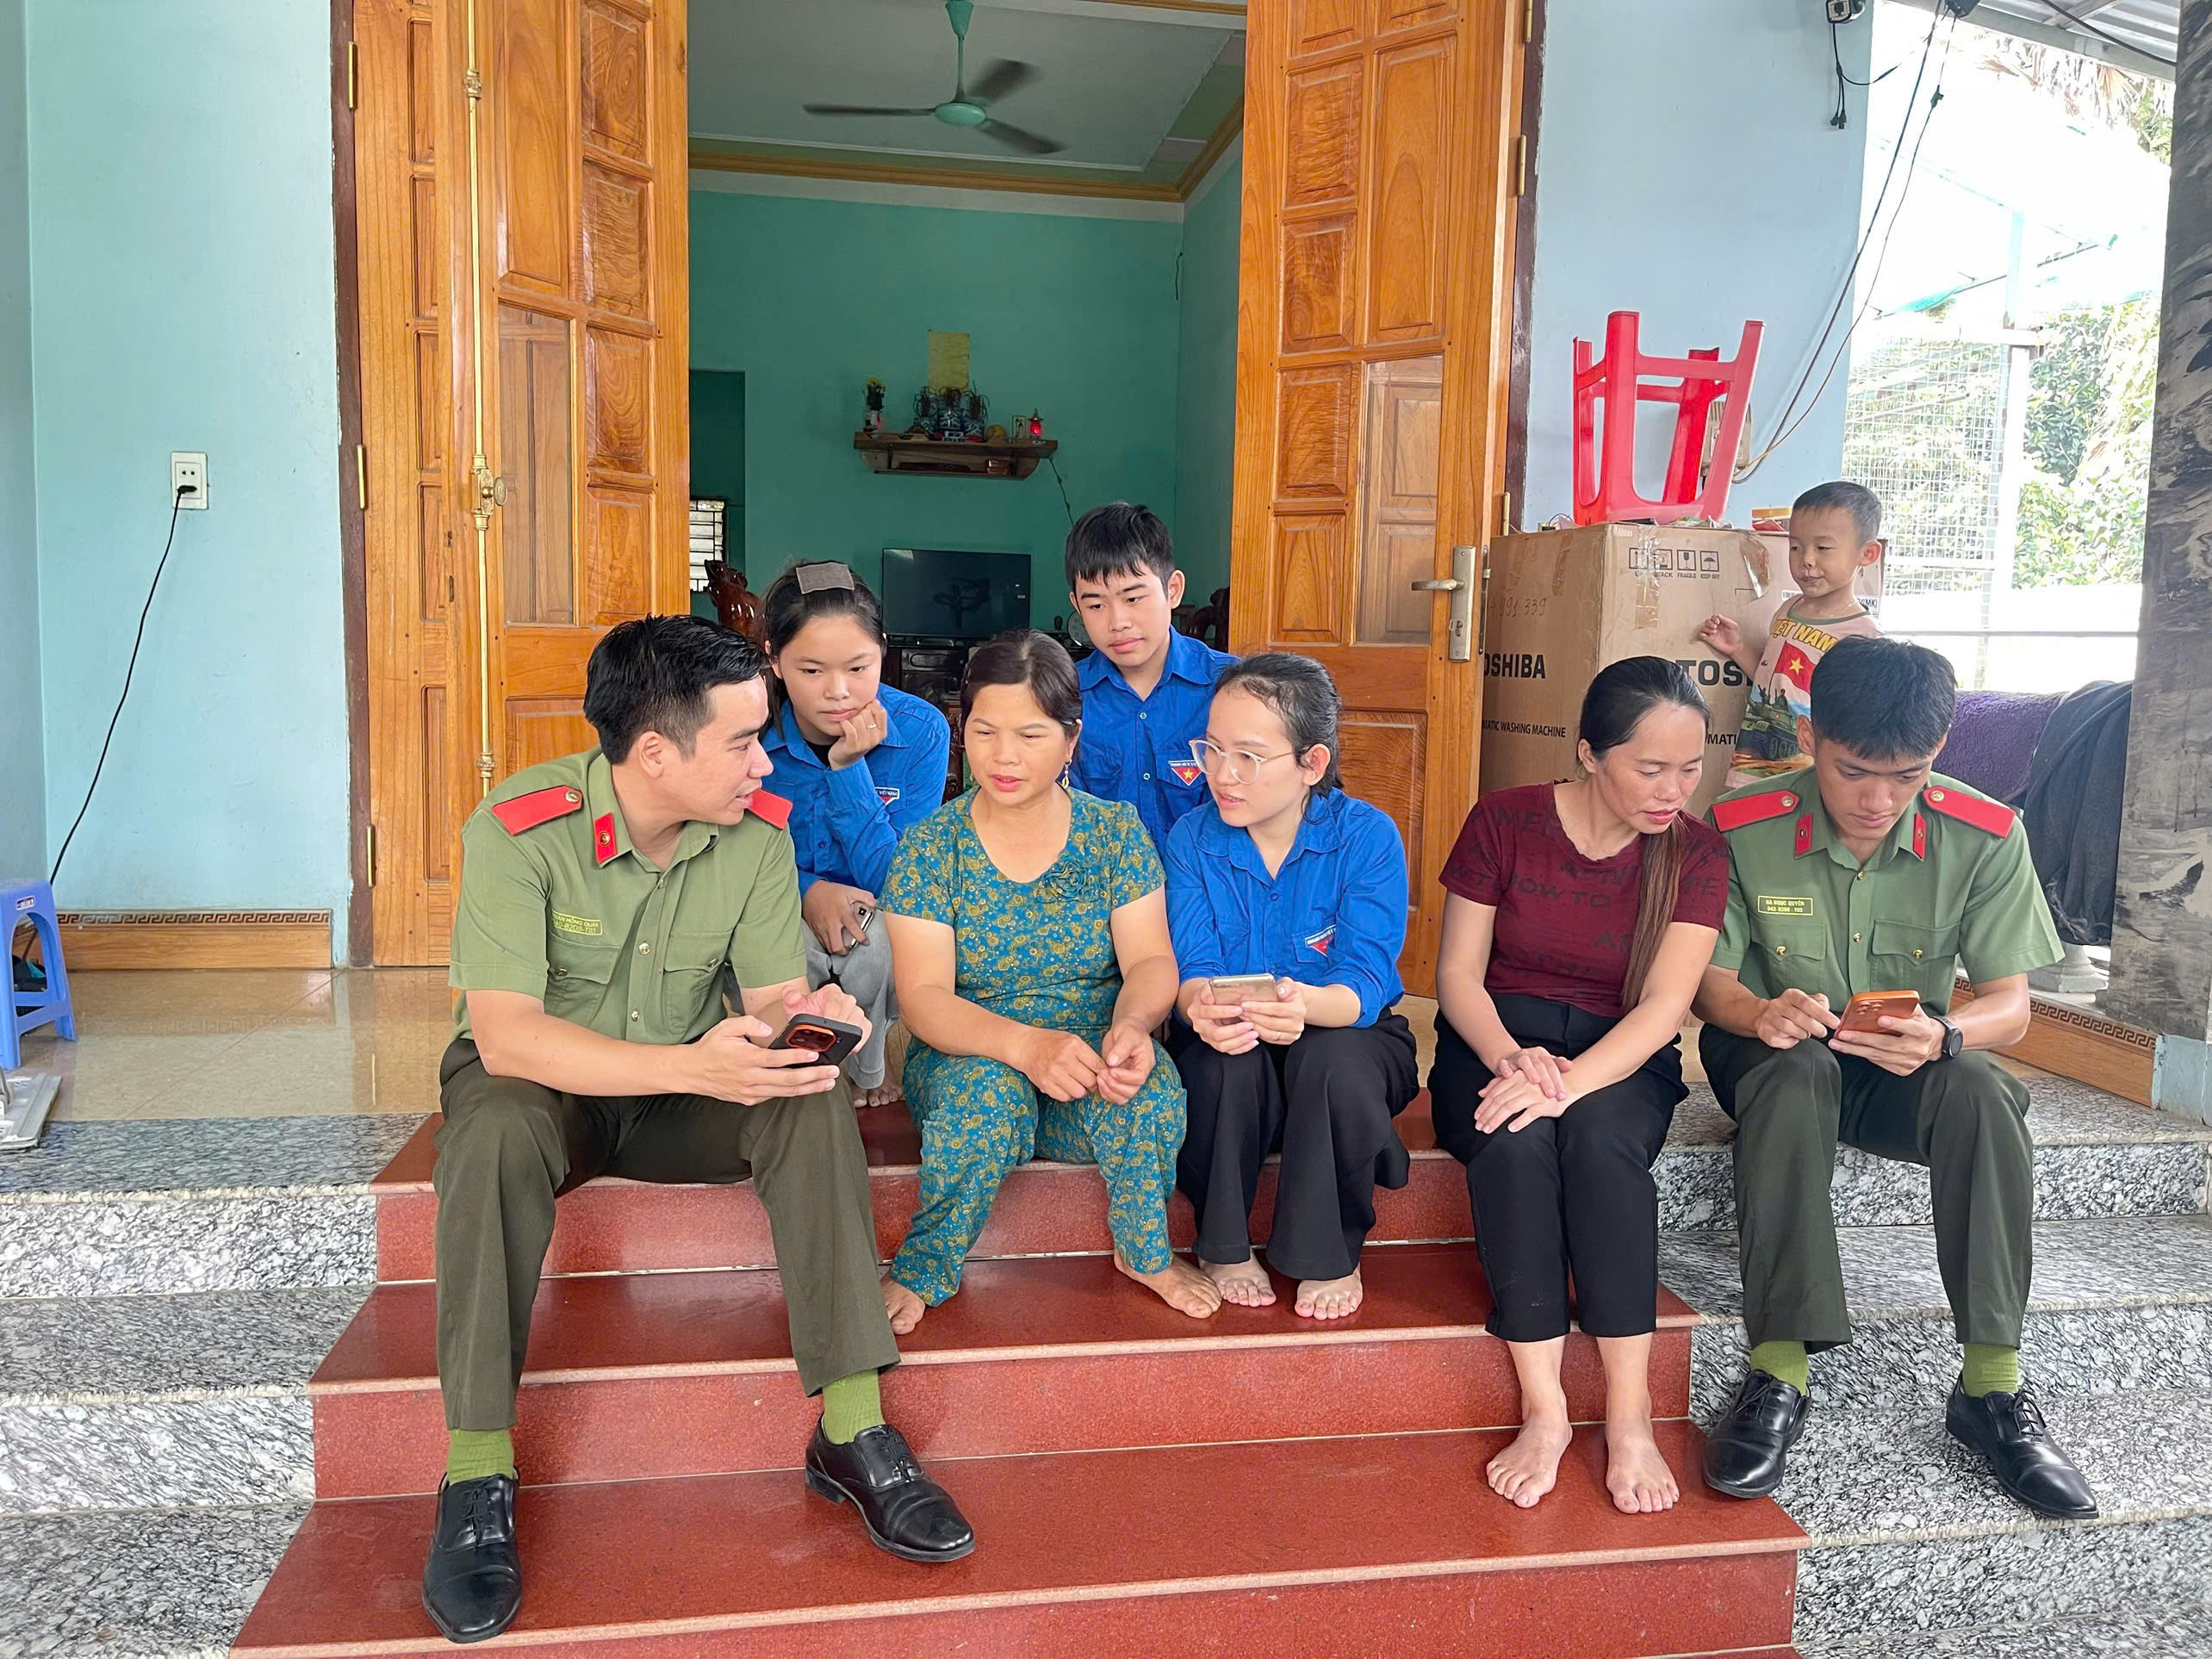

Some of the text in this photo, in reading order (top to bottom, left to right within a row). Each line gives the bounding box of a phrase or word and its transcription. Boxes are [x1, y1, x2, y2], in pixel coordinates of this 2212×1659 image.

[1792, 624, 1840, 653] NAM
[1483, 652, 1546, 679] OSHIBA
[1501, 721, 1531, 735] WASHING
[1532, 724, 1567, 738] MACHINE
